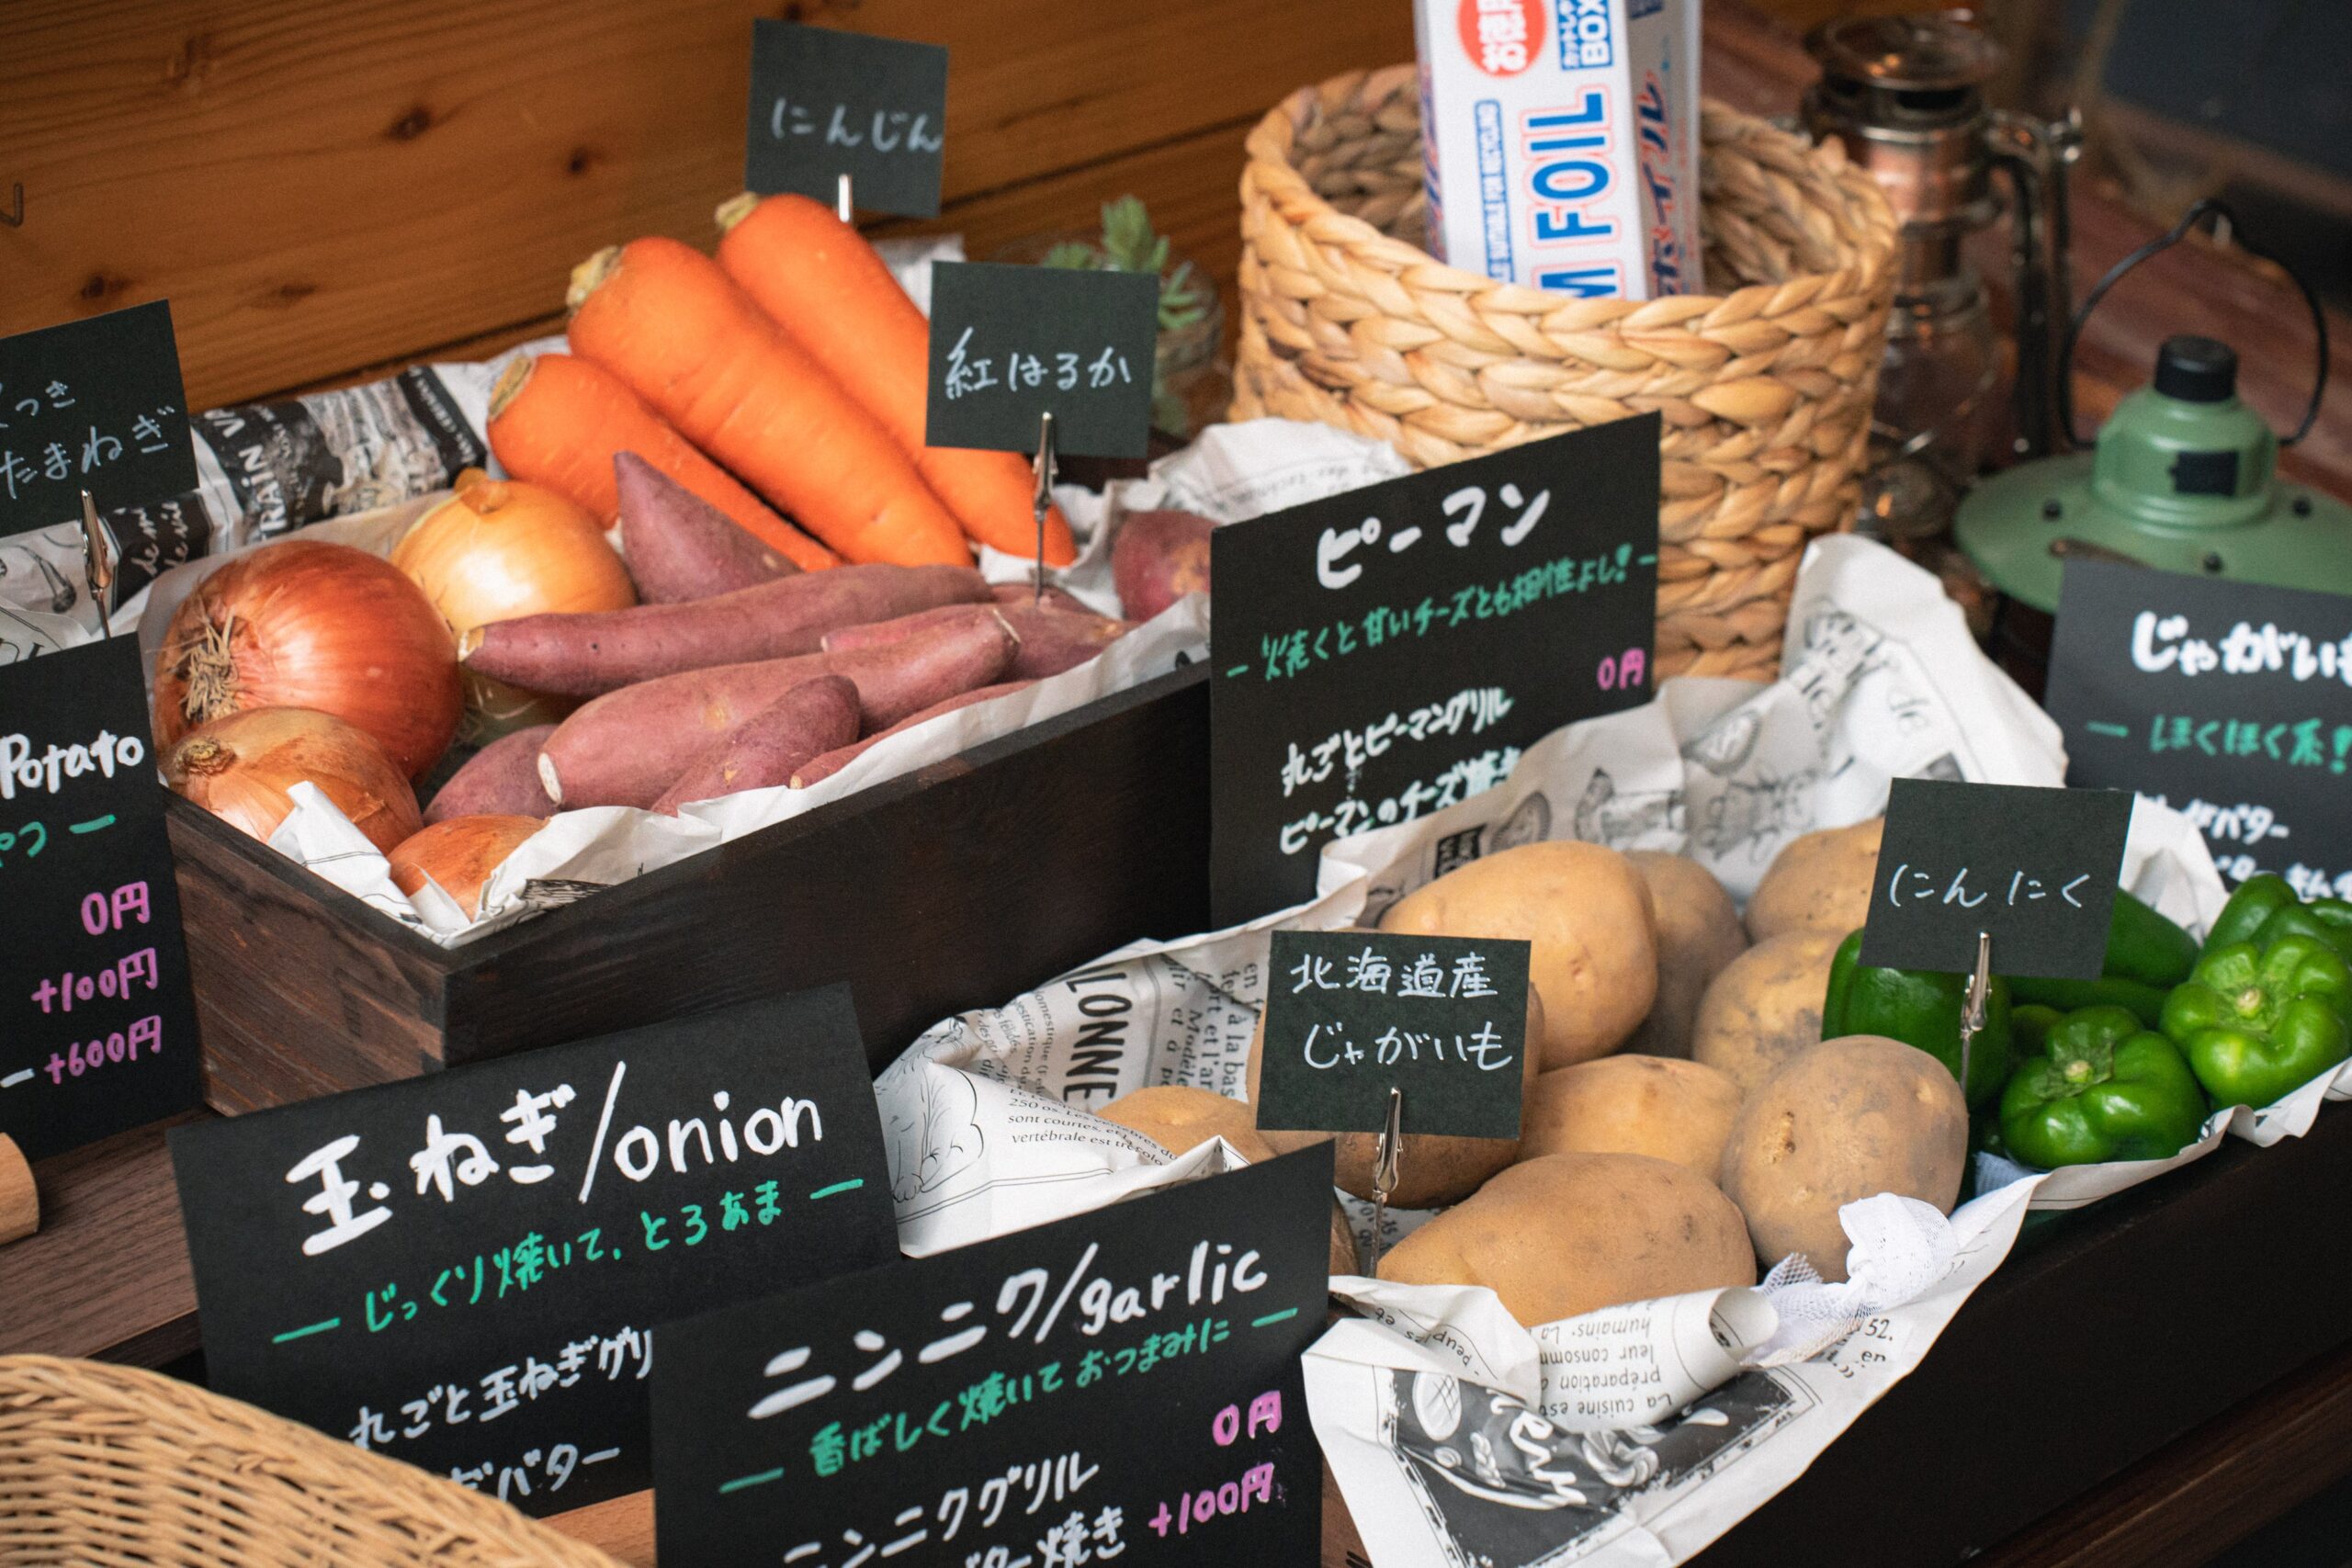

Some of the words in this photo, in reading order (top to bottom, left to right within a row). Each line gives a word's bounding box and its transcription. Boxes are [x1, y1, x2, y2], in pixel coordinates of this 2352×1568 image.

[772, 97, 944, 152] にんじん
[1528, 93, 1612, 241] FOIL
[944, 326, 1132, 400] 紅はるか
[0, 371, 75, 429] つき
[0, 405, 175, 500] たまねぎ
[1317, 482, 1551, 590] ピーマン
[1597, 647, 1646, 691] 0円
[0, 729, 144, 800] Potato
[81, 880, 151, 936] 0円
[1890, 863, 2091, 908] にんにく
[30, 947, 158, 1013] +100円
[1290, 945, 1498, 999] 北海道産
[43, 1014, 162, 1085] +600円
[1303, 1020, 1514, 1072] じゃがいも
[1007, 1114, 1040, 1124] sont
[285, 1061, 821, 1258] 玉ねぎ/onion
[747, 1240, 1268, 1419] ニンニク/garlic
[1619, 1344, 1655, 1364] leur
[1559, 1365, 1661, 1391] préparation
[1212, 1391, 1283, 1446] 0円
[1577, 1399, 1634, 1419] cuisine
[1148, 1461, 1276, 1538] +100円
[965, 1506, 1126, 1568] ター焼き
